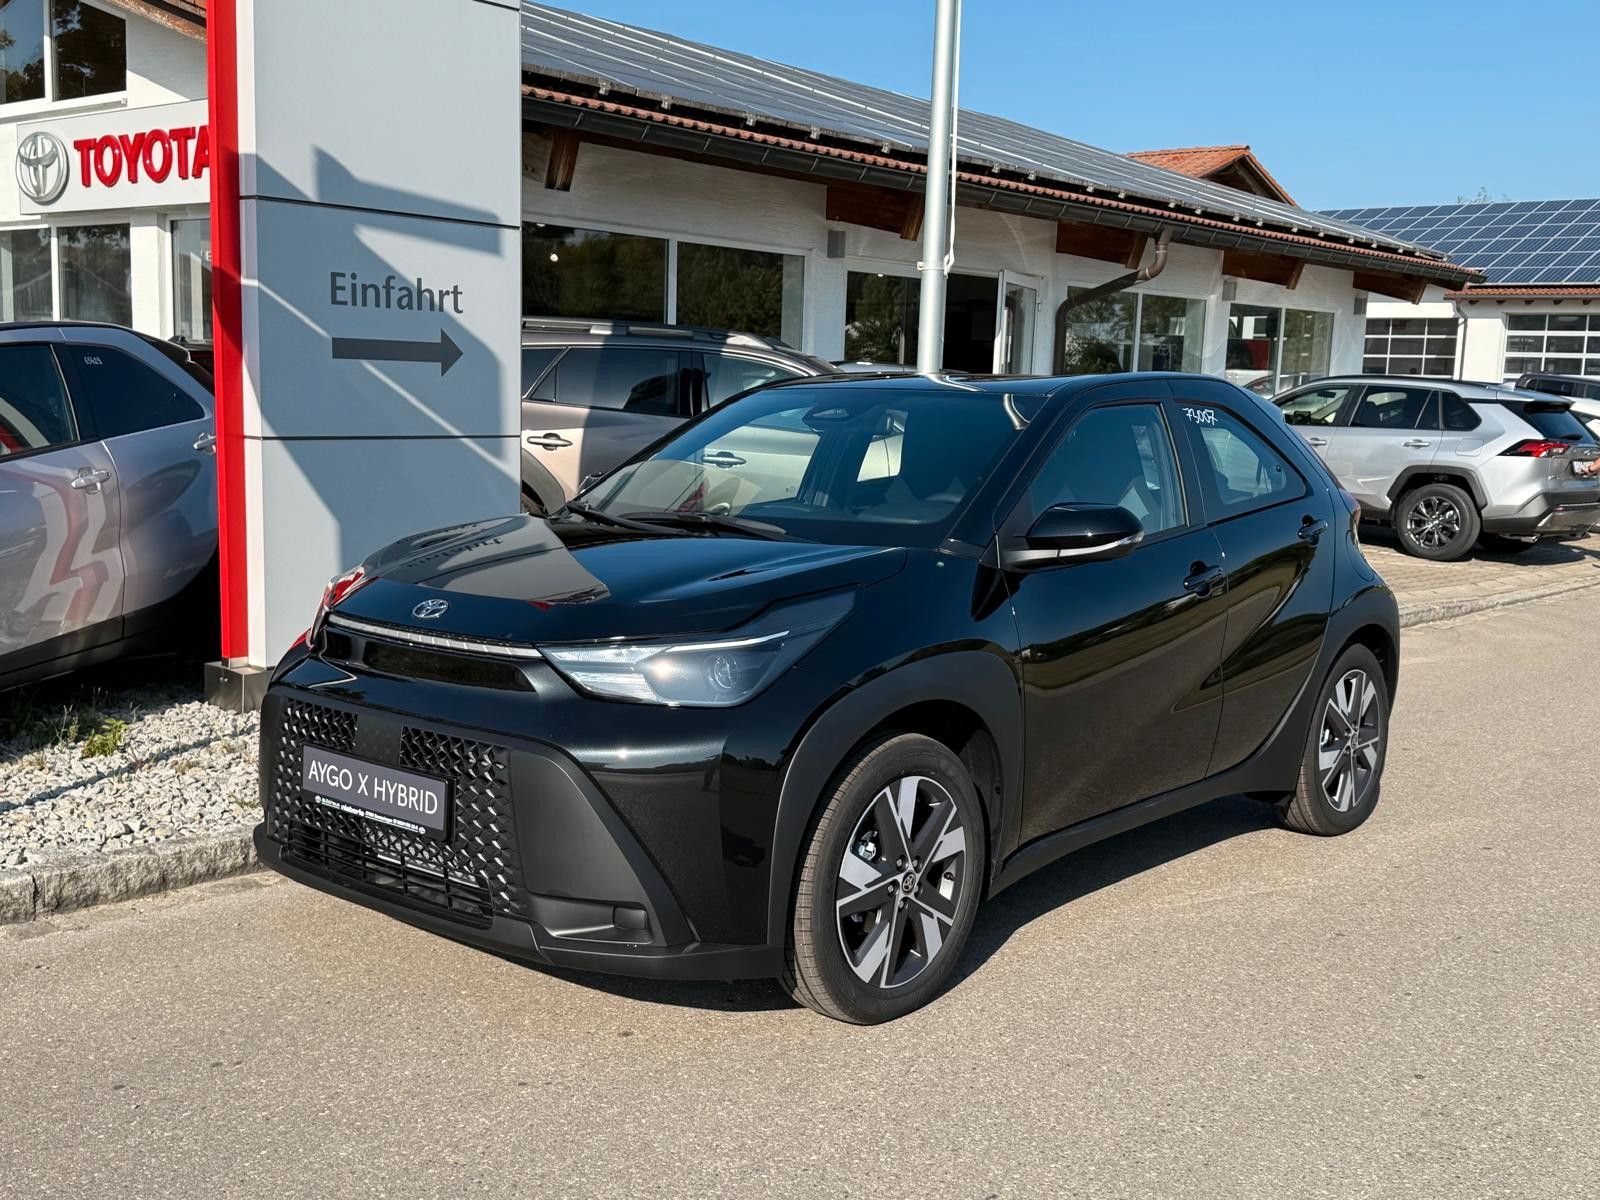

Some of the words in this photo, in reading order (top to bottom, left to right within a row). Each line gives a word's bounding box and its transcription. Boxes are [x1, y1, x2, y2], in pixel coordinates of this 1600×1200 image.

[74, 125, 209, 187] TOYOTA
[330, 271, 464, 314] Einfahrt
[308, 760, 353, 790] AYGO
[357, 772, 369, 796] X
[374, 777, 438, 815] HYBRID
